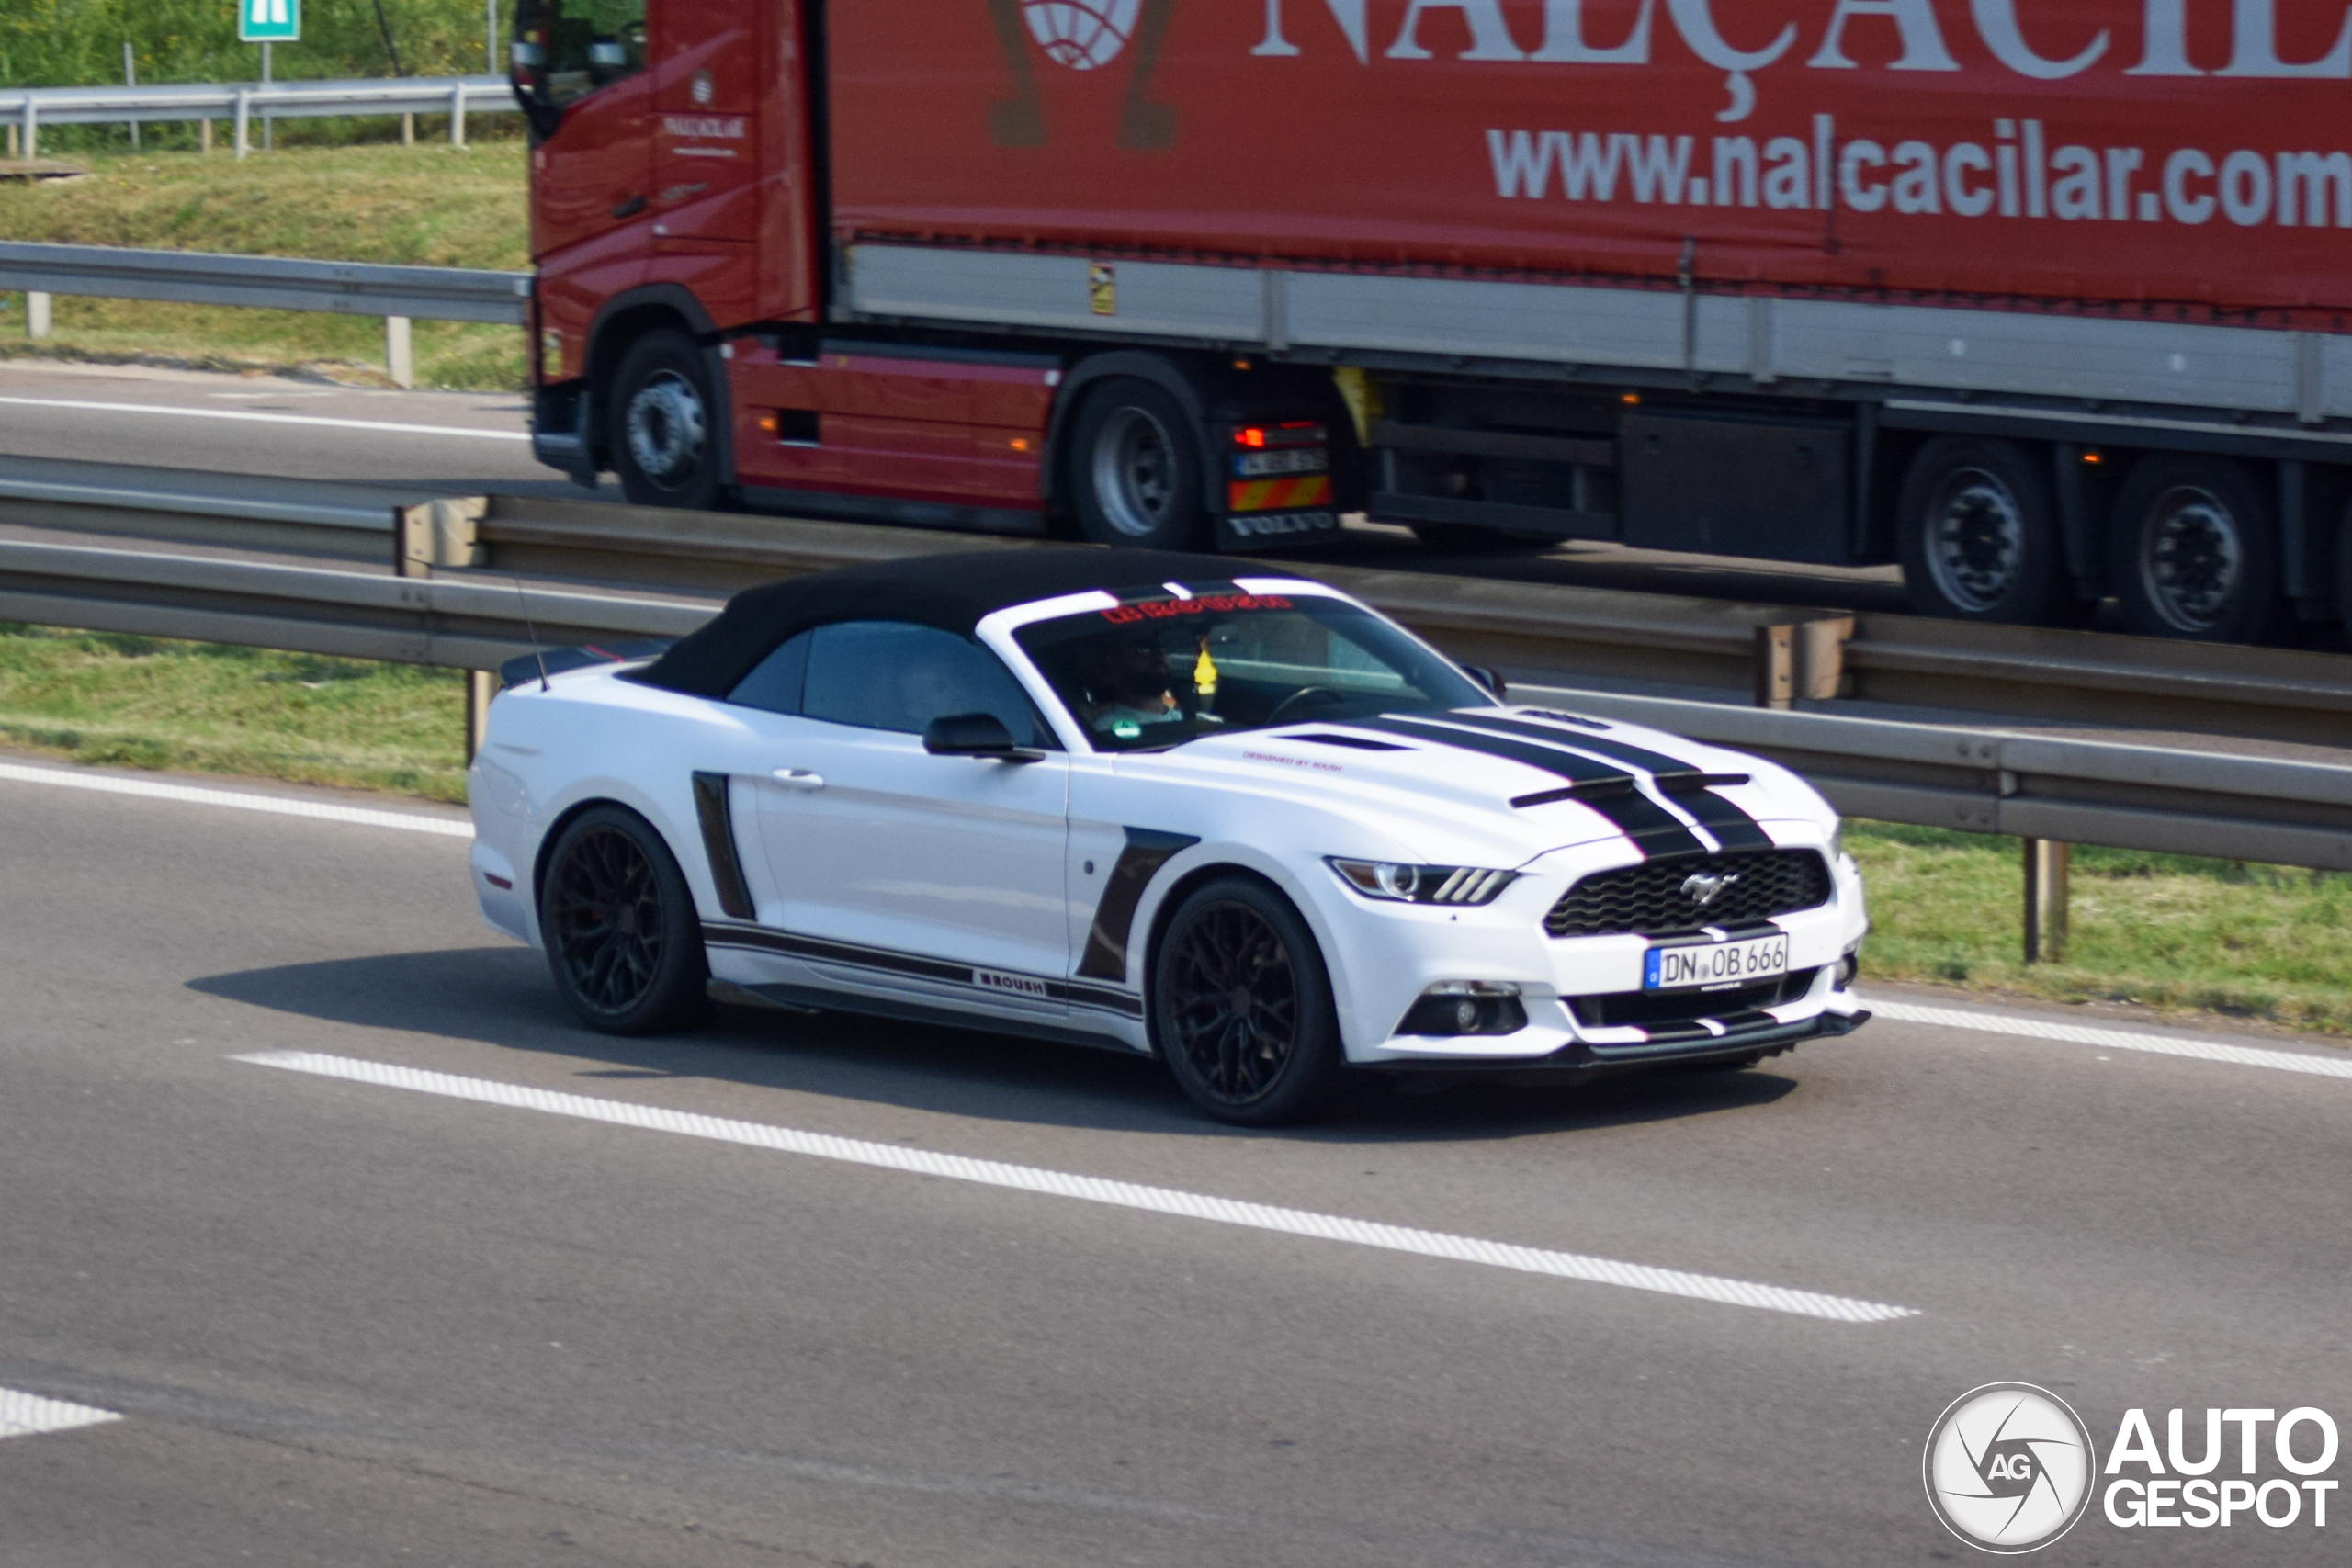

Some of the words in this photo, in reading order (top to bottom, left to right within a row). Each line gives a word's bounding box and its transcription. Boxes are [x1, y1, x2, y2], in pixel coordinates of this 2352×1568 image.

[1485, 113, 2352, 229] www.nalcacilar.com
[1242, 751, 1294, 766] DESIGNED
[1312, 761, 1342, 772] ROUSH
[1664, 952, 1697, 983] DN
[1713, 947, 1741, 976] OB
[1747, 941, 1784, 974] 666
[993, 975, 1044, 995] ROUSH
